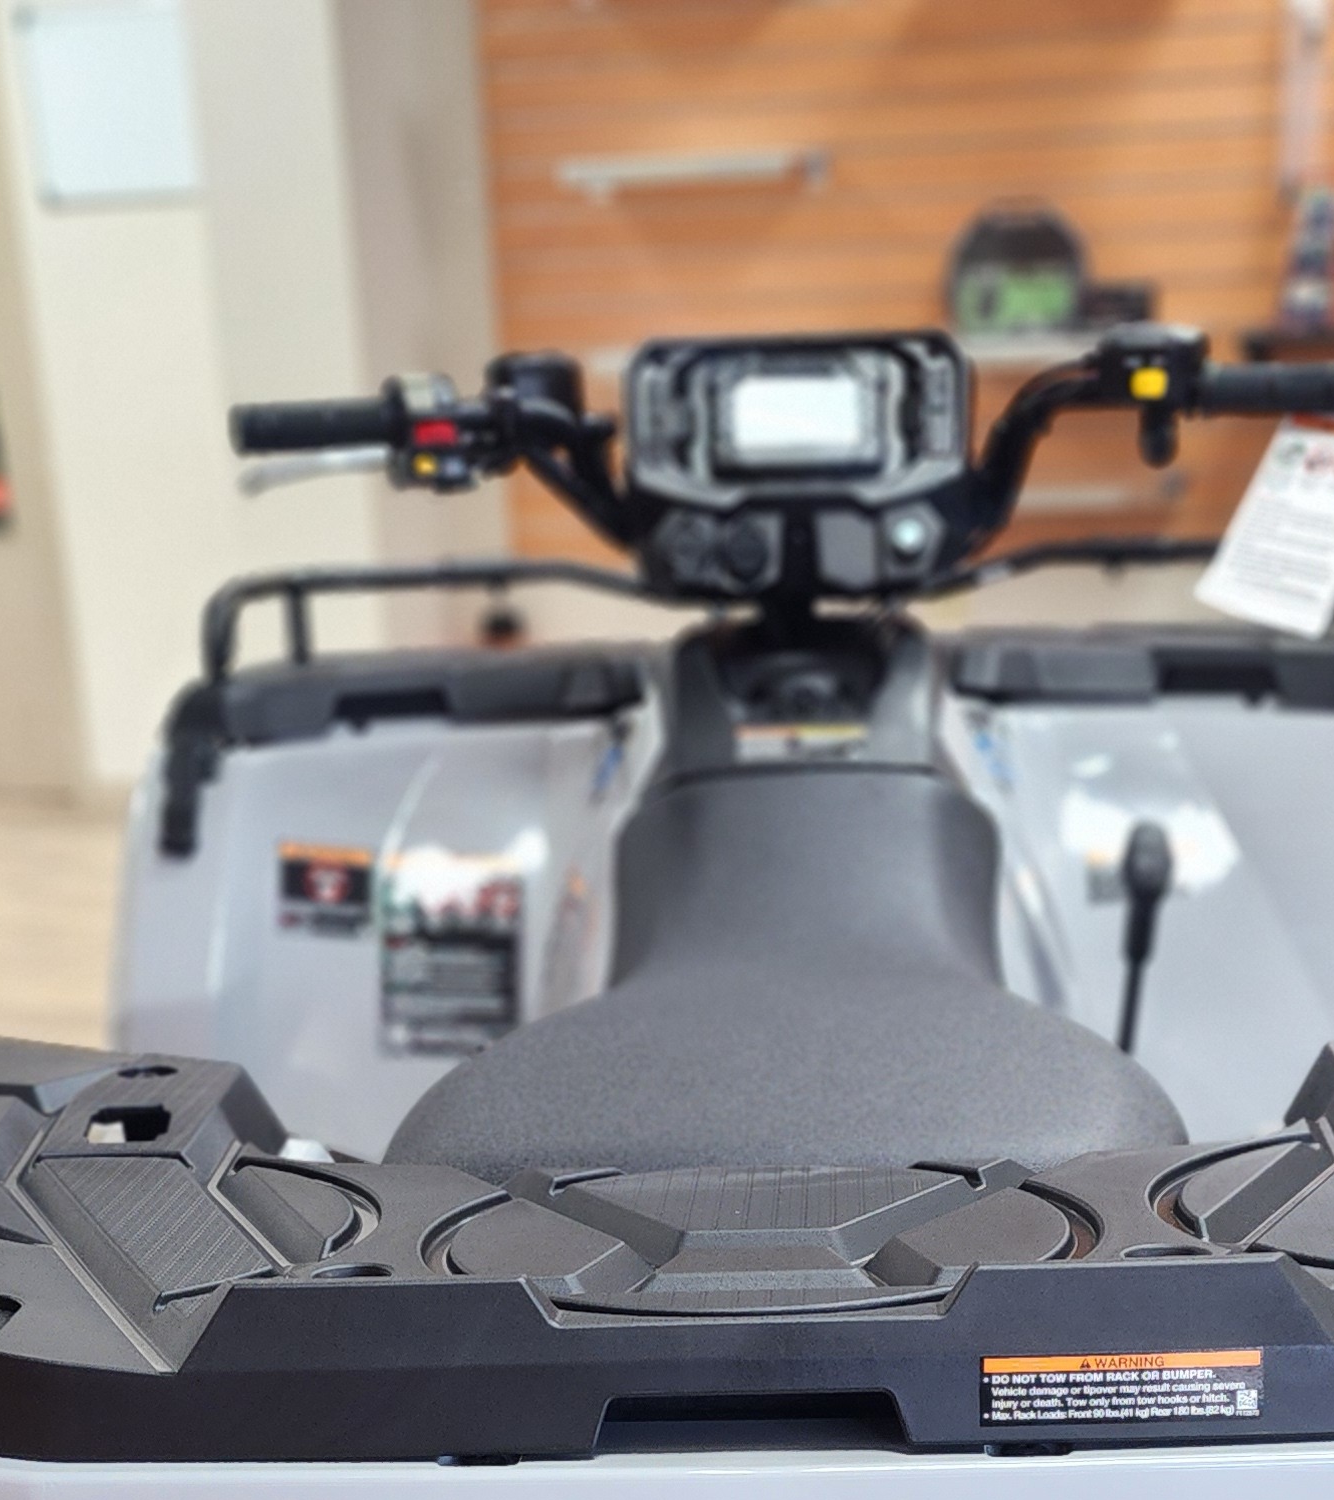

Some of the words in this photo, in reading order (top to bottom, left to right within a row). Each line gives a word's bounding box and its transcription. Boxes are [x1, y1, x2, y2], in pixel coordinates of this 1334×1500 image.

[1094, 1355, 1165, 1369] WARNING
[991, 1375, 1010, 1385] DO
[1012, 1374, 1037, 1384] NOT
[1039, 1373, 1067, 1384] TOW
[1069, 1372, 1104, 1383] FROM
[1106, 1371, 1140, 1382] RACK
[1141, 1370, 1160, 1381] OR
[1162, 1369, 1217, 1380] BUMPER.
[991, 1387, 1027, 1396] Vehicle
[1028, 1386, 1069, 1397] damage
[1070, 1387, 1082, 1395] or
[1083, 1385, 1118, 1396] tipover
[1119, 1384, 1141, 1395] may
[1142, 1382, 1171, 1393] result
[1172, 1382, 1211, 1392] causing
[1211, 1381, 1246, 1391] severe
[1020, 1400, 1031, 1408] or
[1032, 1398, 1064, 1408] death.
[1066, 1397, 1088, 1407] Tow
[1089, 1396, 1110, 1407] only
[1111, 1396, 1136, 1406] from
[1137, 1396, 1157, 1405] tow
[1157, 1394, 1188, 1404] hooks
[1189, 1395, 1201, 1403] or
[1201, 1392, 1230, 1403] hitch.
